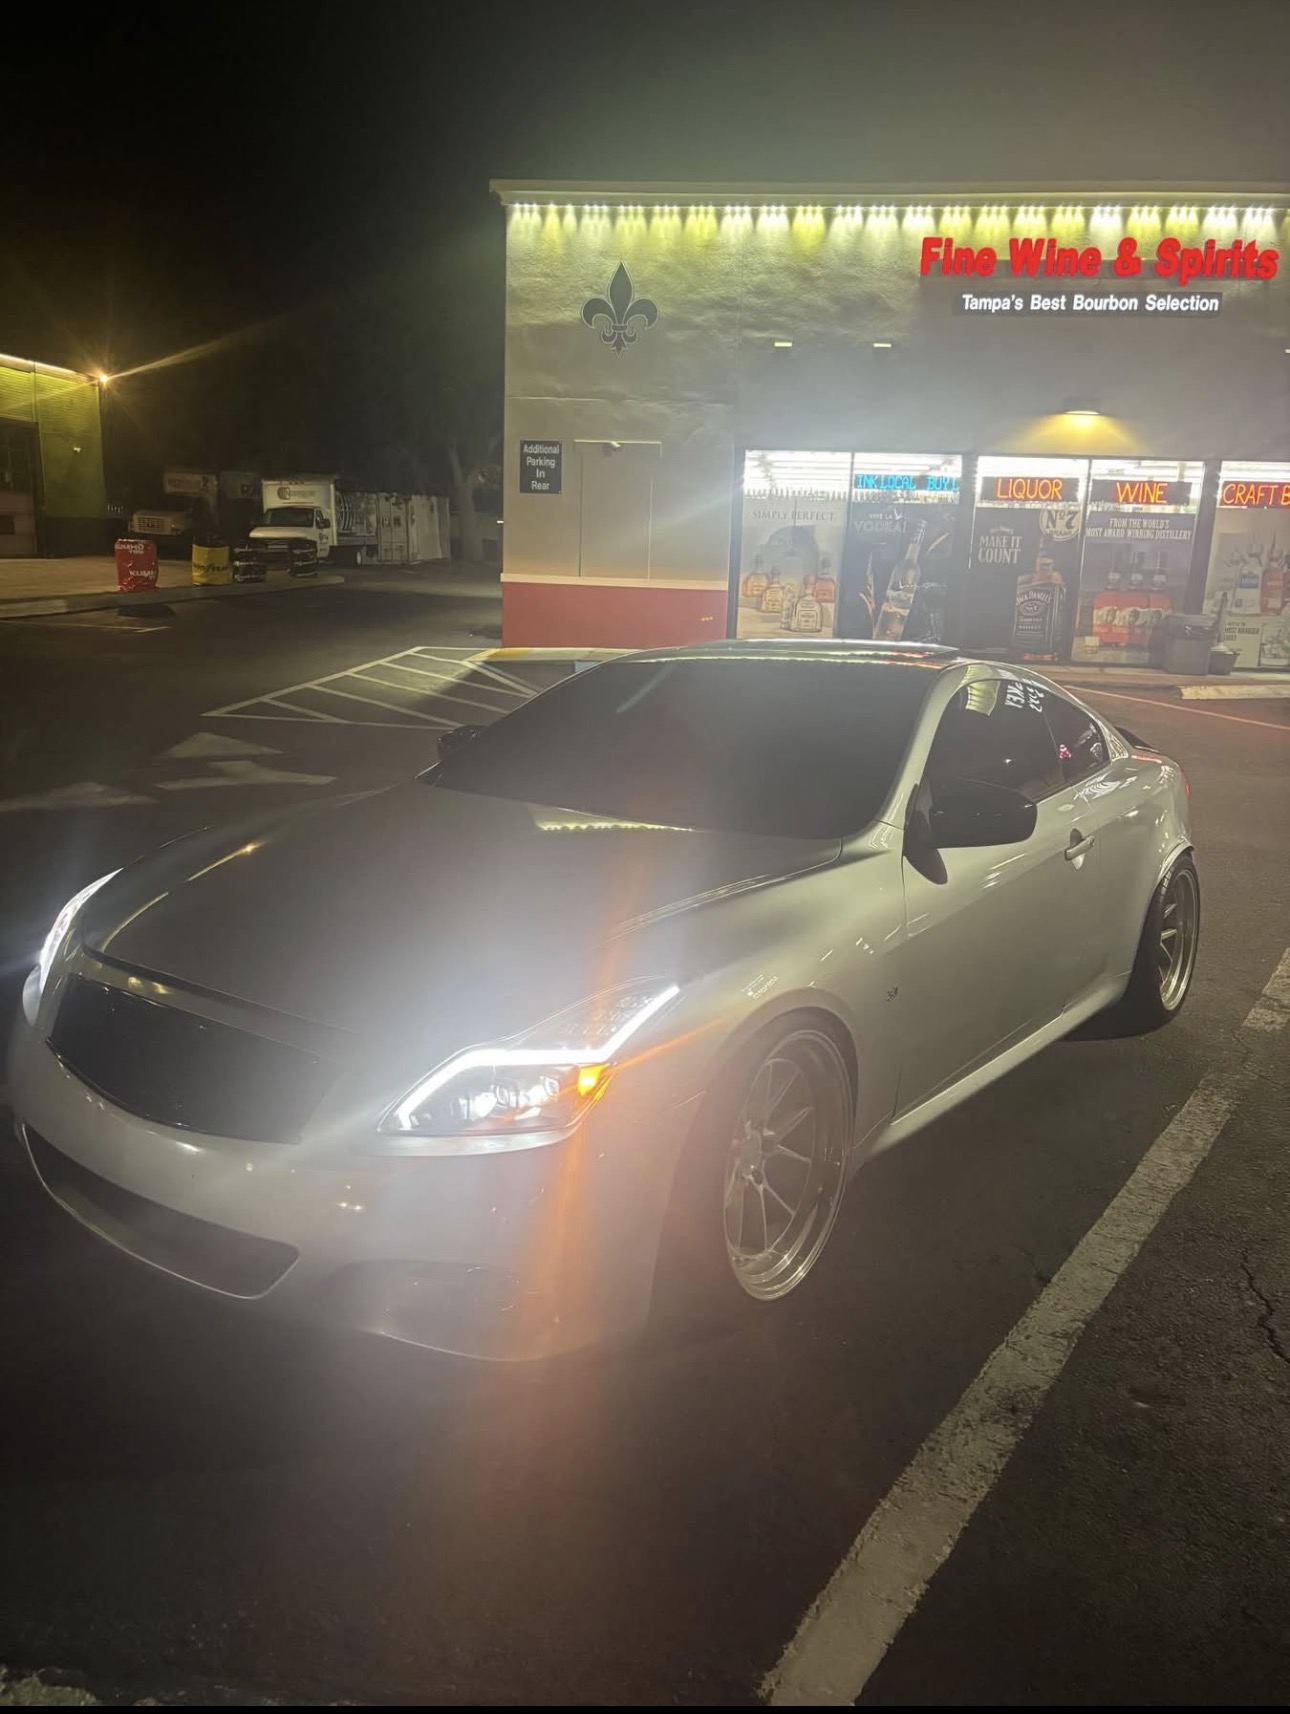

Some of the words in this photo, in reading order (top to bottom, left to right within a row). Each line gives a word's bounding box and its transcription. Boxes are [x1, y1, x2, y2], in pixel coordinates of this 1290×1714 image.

[920, 236, 998, 278] Fine
[1009, 237, 1102, 278] Wine
[1113, 236, 1142, 278] &
[1155, 237, 1280, 286] Spirits
[962, 293, 1024, 314] Tampa's
[1030, 294, 1067, 310] Best
[1073, 294, 1138, 311] Bourbon
[1145, 294, 1220, 312] Selection
[523, 444, 560, 454] Additional
[526, 456, 556, 469] Parking
[536, 468, 546, 479] In
[531, 480, 550, 490] Rear
[880, 475, 917, 490] LOCAL
[927, 477, 950, 491] BUY
[996, 478, 1063, 500] LIQUOR
[1116, 482, 1168, 503] WINE
[1222, 483, 1278, 506] CRAFT
[752, 510, 787, 519] SIMPLY
[979, 535, 1009, 547] MAKE
[1010, 535, 1023, 548] IT
[978, 547, 1021, 564] COUNT
